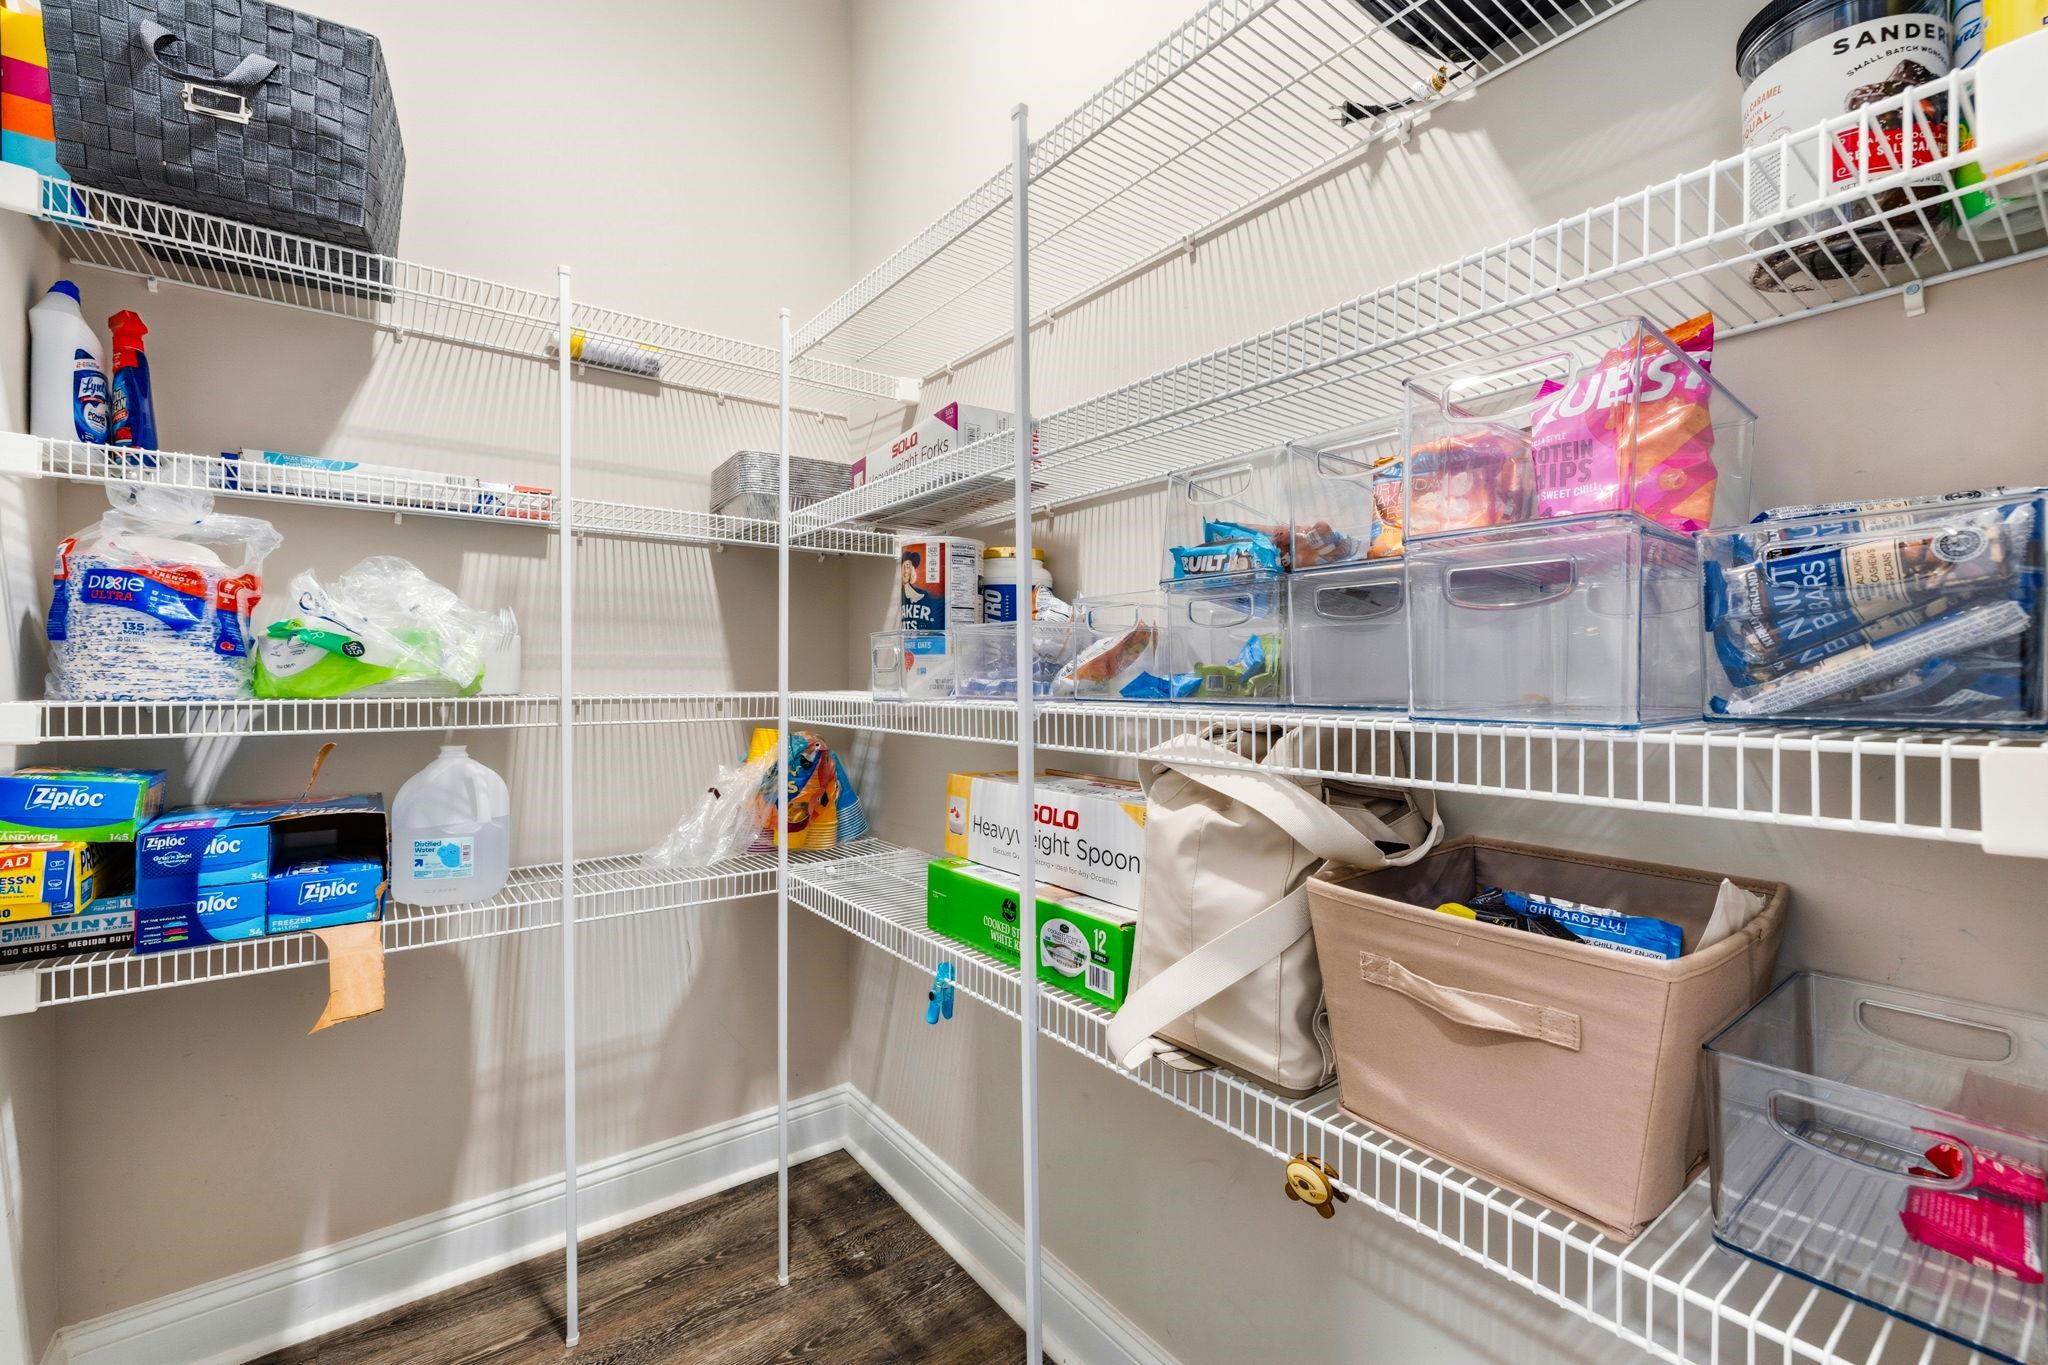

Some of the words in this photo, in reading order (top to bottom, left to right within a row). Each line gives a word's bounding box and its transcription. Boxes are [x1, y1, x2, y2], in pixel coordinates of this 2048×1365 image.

[1832, 22, 1947, 55] SANDER
[1846, 54, 1884, 77] SMALL
[1885, 45, 1919, 56] BATCH
[1744, 110, 1771, 139] QUAL
[892, 432, 918, 458] SOLO
[921, 439, 949, 462] Forks
[1537, 438, 1594, 464] OTEIN
[1537, 459, 1593, 490] HIPS
[1541, 488, 1572, 501] SWEET
[1181, 553, 1228, 574] BUILT
[91, 590, 133, 601] ULTRA
[902, 604, 931, 621] AKER
[33, 787, 105, 810] Ziploc
[147, 836, 186, 850] Ziploc
[204, 838, 241, 855] loc
[973, 815, 1070, 857] Heavyight
[1077, 839, 1141, 873] Spoon
[0, 856, 29, 869] AD
[0, 875, 36, 885] ESS'N
[0, 886, 24, 894] EAL
[304, 882, 358, 902] Ziploc
[52, 915, 134, 932] VINYL
[272, 916, 312, 926] FREEZER
[983, 915, 1011, 935] COOKED
[1528, 903, 1623, 931] GHIRARDELLI
[22, 944, 57, 954] GLOVES
[68, 938, 106, 948] MEDIUM
[990, 929, 1013, 948] WHITE
[1093, 928, 1107, 955] 12
[1593, 940, 1614, 950] CHILL
[1615, 945, 1633, 954] AND
